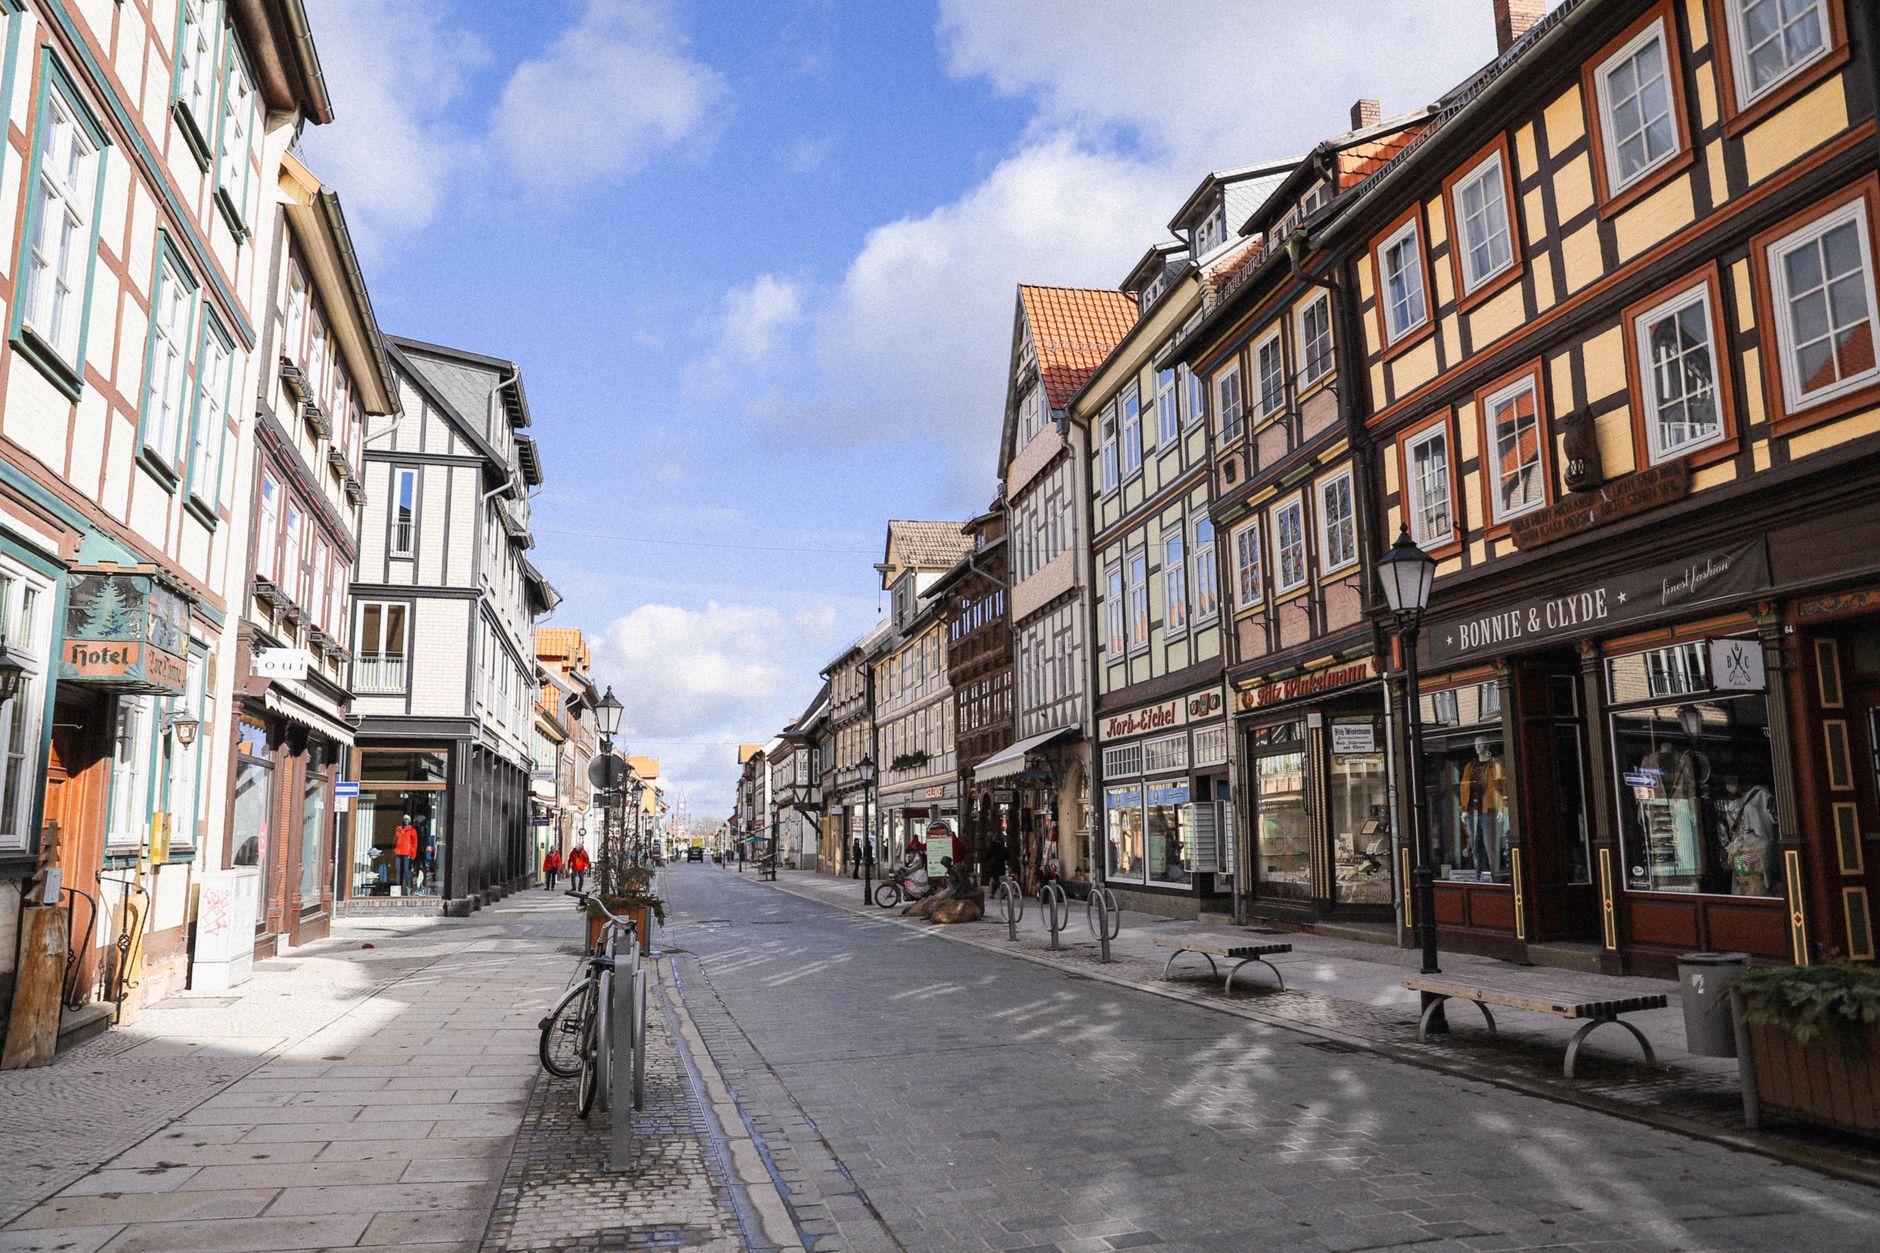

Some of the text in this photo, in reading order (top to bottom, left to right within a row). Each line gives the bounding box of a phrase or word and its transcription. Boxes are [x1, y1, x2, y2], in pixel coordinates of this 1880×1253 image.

[1661, 558, 1730, 606] finest fashion
[1458, 587, 1608, 651] BONNIE & CLYDE
[71, 644, 129, 668] Hotel
[264, 657, 304, 671] oui
[1283, 662, 1368, 699] Winkelmann
[1106, 702, 1176, 738] Korb-Eichel
